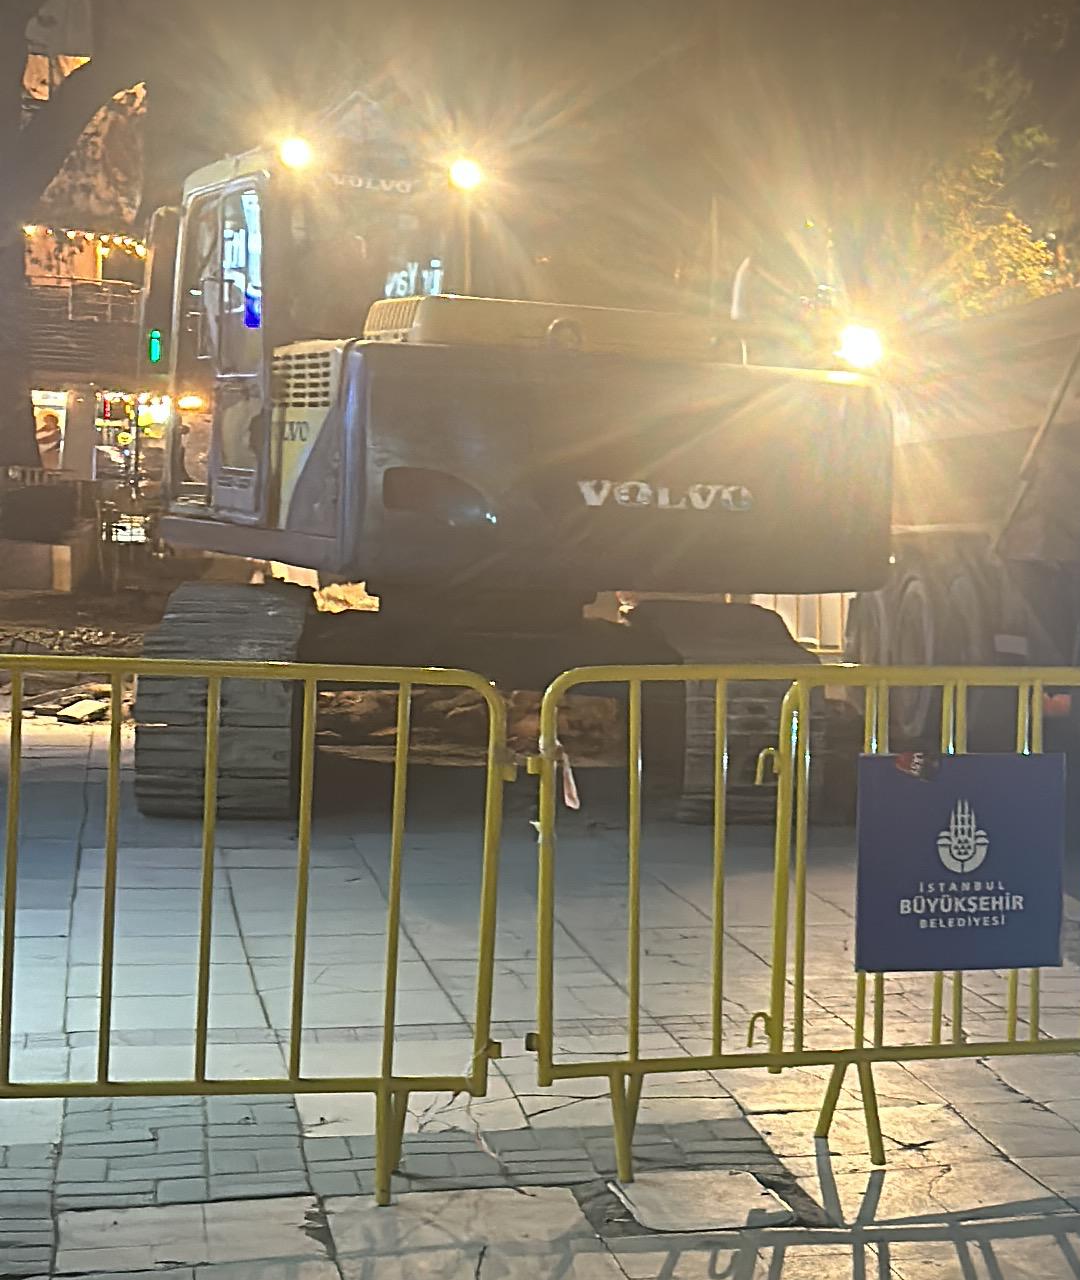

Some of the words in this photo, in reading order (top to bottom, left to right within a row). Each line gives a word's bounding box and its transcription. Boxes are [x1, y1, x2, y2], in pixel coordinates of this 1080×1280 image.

[577, 479, 753, 511] VOLVO
[919, 881, 1005, 893] İSTANBUL
[899, 892, 1025, 914] BÜYÜKŞEHİR
[919, 914, 1006, 929] BELEDİYESİ
